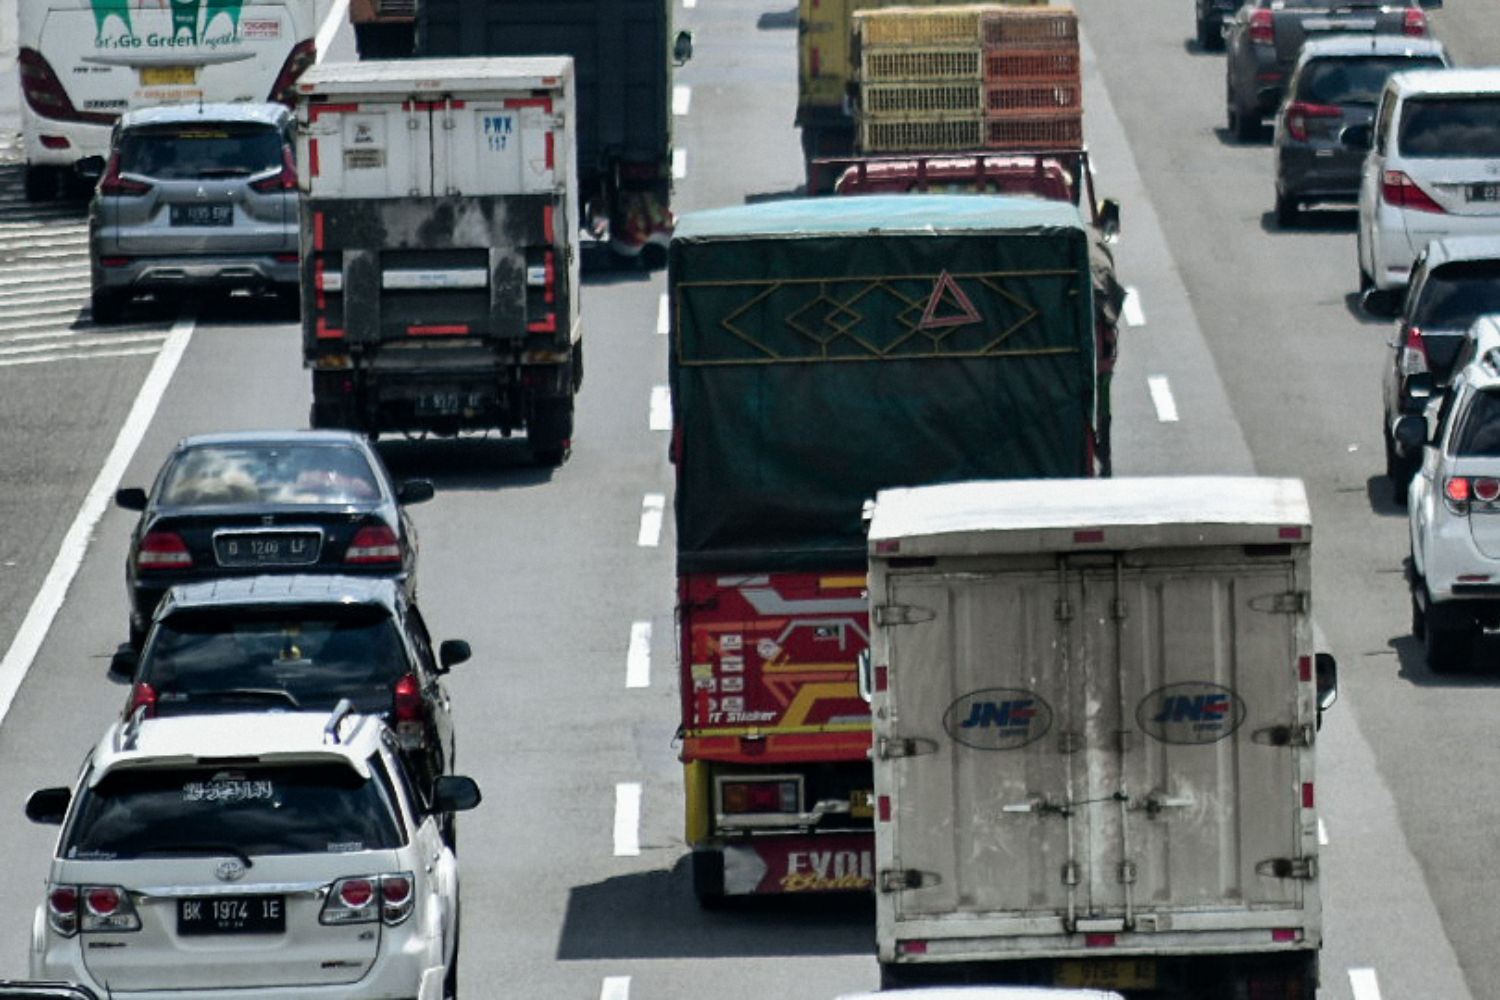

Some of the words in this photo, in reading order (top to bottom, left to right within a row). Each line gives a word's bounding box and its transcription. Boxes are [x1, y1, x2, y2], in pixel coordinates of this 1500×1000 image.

[119, 34, 142, 48] Go
[147, 33, 197, 48] Green
[484, 116, 513, 134] PWK
[961, 699, 1037, 728] JNE
[1155, 694, 1230, 722] JNE
[183, 901, 201, 920] BK
[212, 901, 248, 919] 1974
